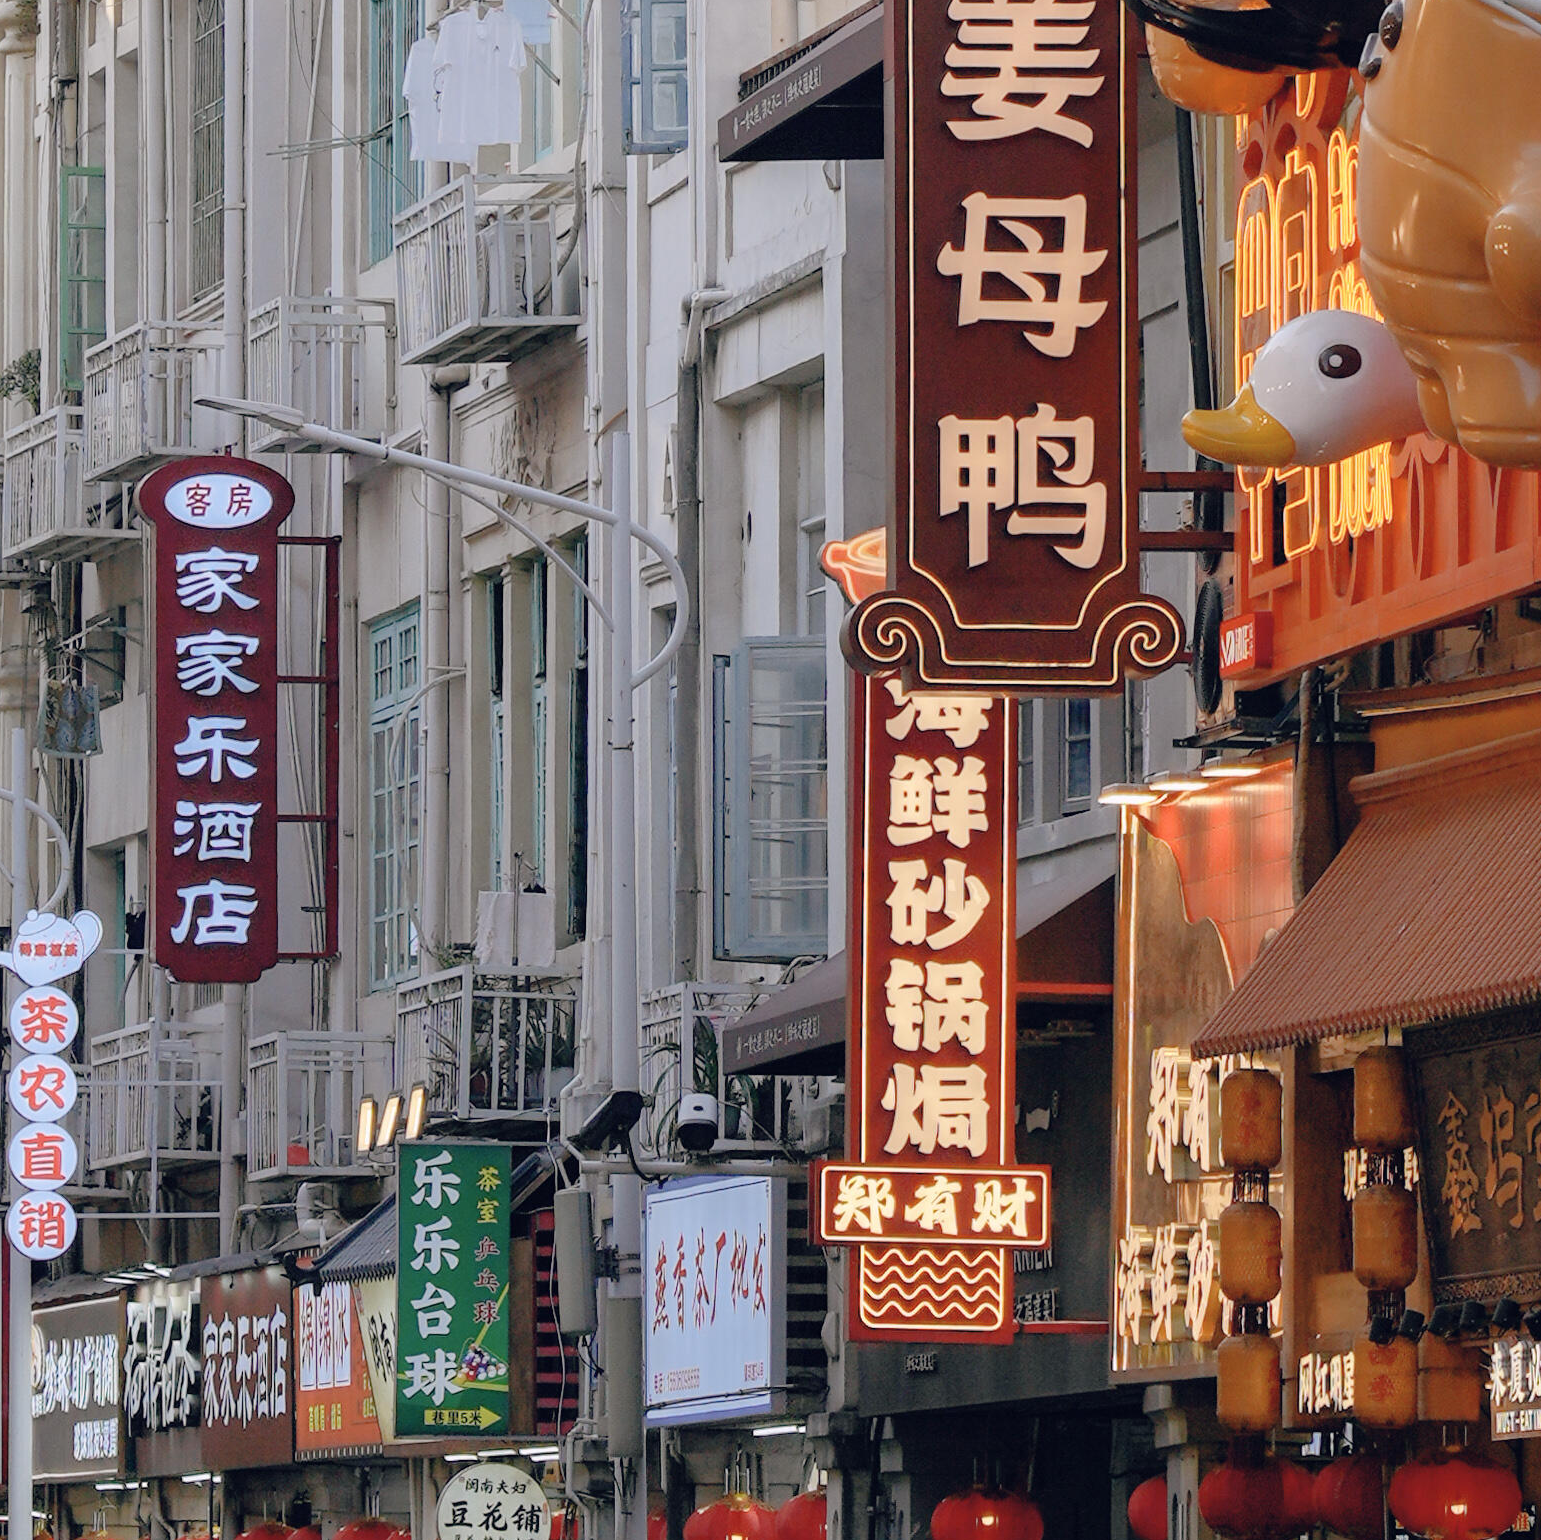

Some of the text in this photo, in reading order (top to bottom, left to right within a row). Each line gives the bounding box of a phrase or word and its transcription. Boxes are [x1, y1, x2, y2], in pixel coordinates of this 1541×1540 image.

[185, 483, 252, 517] 客房
[171, 547, 262, 946] 家家乐酒店
[18, 996, 69, 1250] 茶农直销
[474, 1166, 502, 1325] 茶室 乒乓球
[833, 1176, 1037, 1239] 郑有财
[402, 1150, 465, 1407] 乐乐台球
[203, 1302, 288, 1429] 家家乐酒店
[444, 1501, 543, 1534] 豆花铺
[465, 1478, 527, 1496] 闽南夫妇
